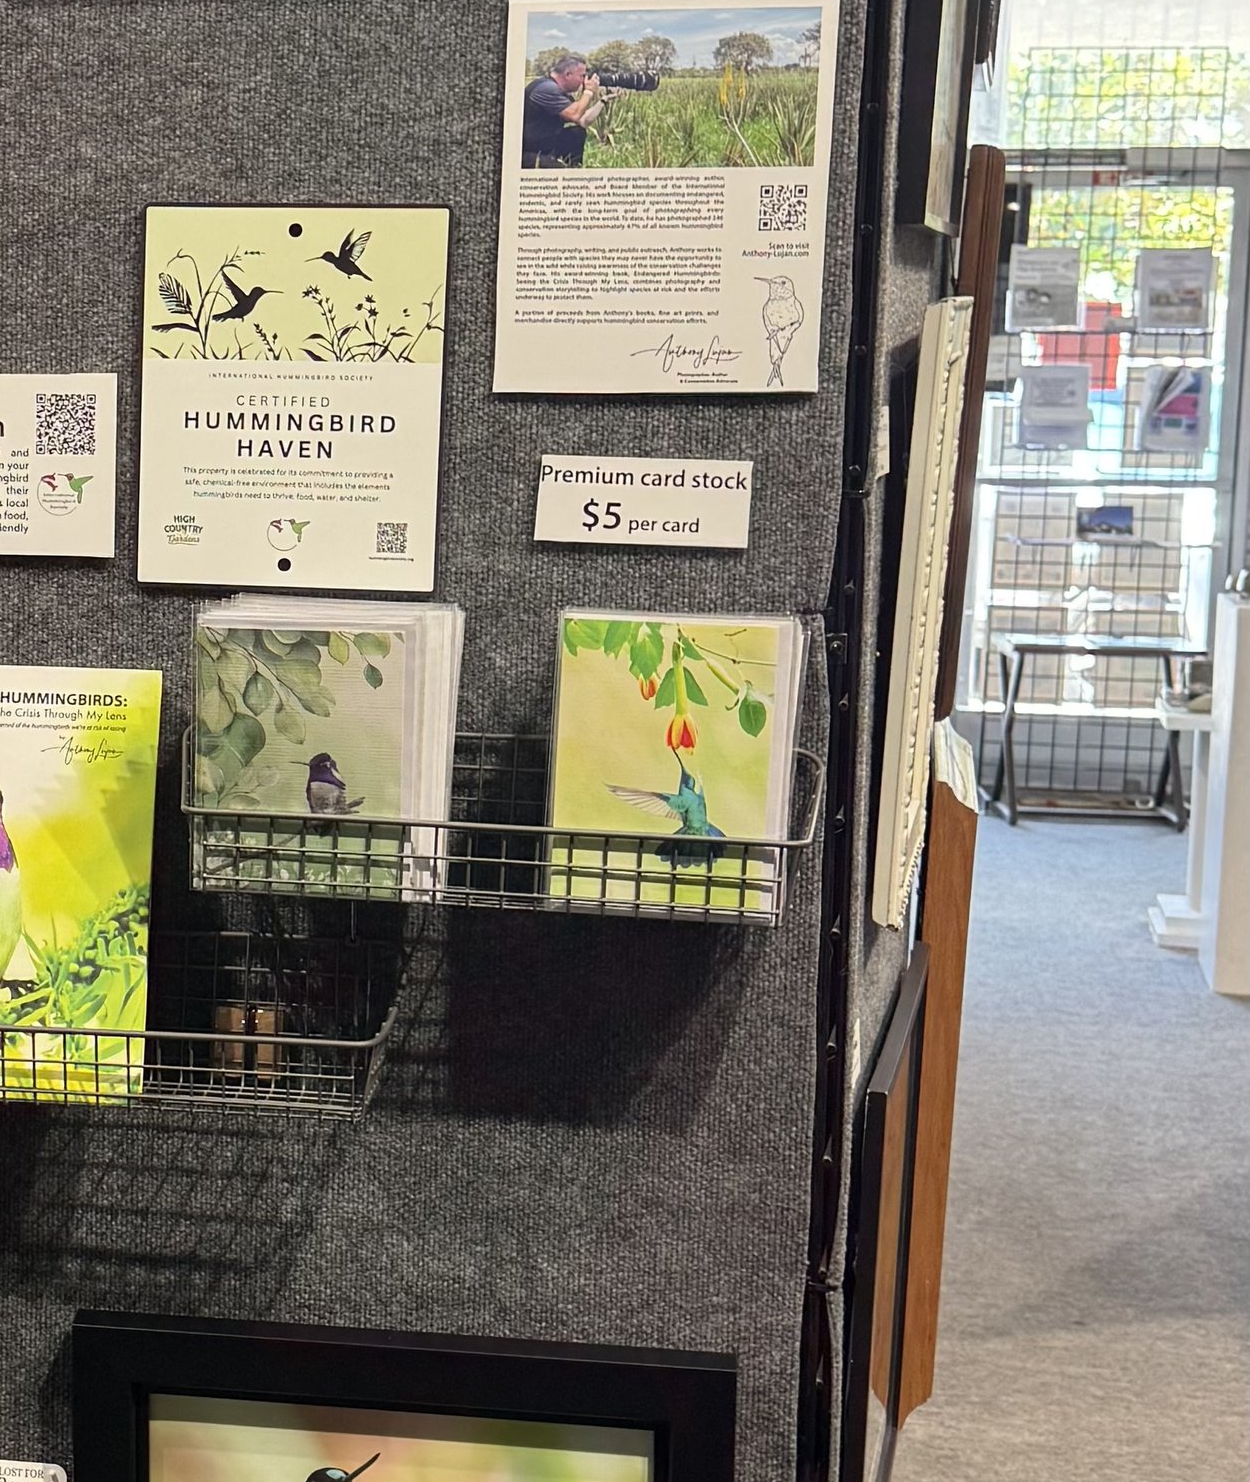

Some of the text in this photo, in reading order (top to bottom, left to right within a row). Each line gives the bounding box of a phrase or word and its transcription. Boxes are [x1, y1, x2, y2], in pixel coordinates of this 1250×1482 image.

[768, 242, 784, 250] Scan
[236, 394, 329, 407] CERTIFIED
[184, 411, 395, 432] HUMMINGBIRD
[10, 447, 29, 457] and
[237, 439, 332, 458] HAVEN
[7, 462, 29, 471] your
[541, 464, 746, 489] Premium card stock
[6, 485, 28, 494] their
[6, 497, 28, 507] local
[4, 509, 28, 520] food,
[173, 514, 195, 523] HIGH
[582, 498, 699, 534] $5 per card
[163, 524, 203, 535] COUNTRY
[0, 691, 127, 707] HUMMINGBIRDS:
[14, 707, 40, 717] Crisis
[44, 707, 82, 721] Through
[86, 710, 102, 722] My
[105, 710, 126, 720] Lens
[24, 1468, 46, 1481] FOR
